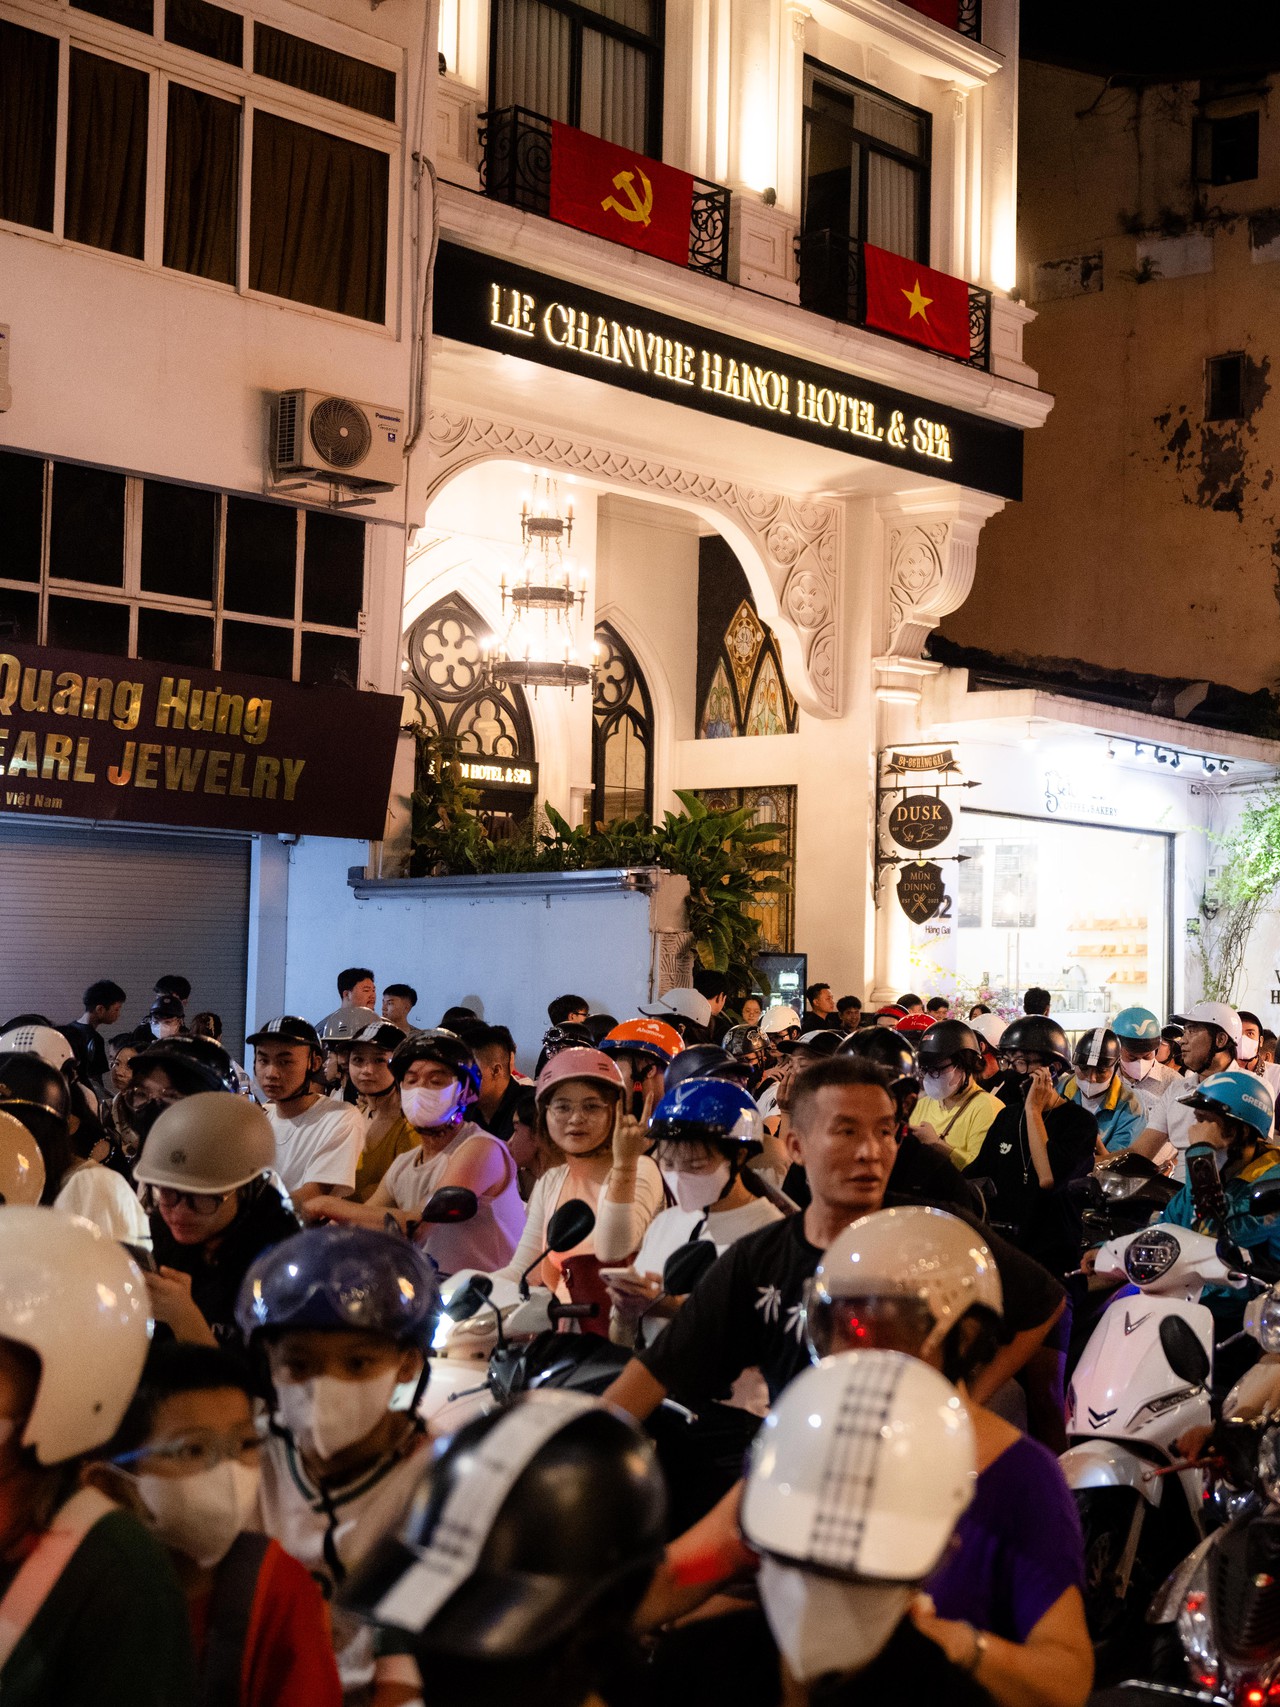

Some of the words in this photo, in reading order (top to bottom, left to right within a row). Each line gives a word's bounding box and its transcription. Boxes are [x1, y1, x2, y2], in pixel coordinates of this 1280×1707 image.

[490, 283, 535, 337] LE
[543, 302, 695, 386] CHANVRE
[701, 350, 791, 415] HANOI
[797, 380, 883, 442] HOTEL
[888, 410, 909, 449] &
[912, 417, 952, 462] SPA
[0, 653, 144, 731] Quang
[155, 676, 273, 745] Hưng
[107, 741, 306, 801] JEWELRY
[470, 763, 504, 782] HOTEL
[505, 767, 513, 783] &
[513, 768, 532, 785] SPA
[6, 791, 31, 808] Việt
[34, 794, 63, 809] Nam
[897, 805, 942, 822] DUSK
[904, 883, 936, 891] DINING
[941, 925, 951, 935] Gai
[1241, 1093, 1269, 1113] GREEN
